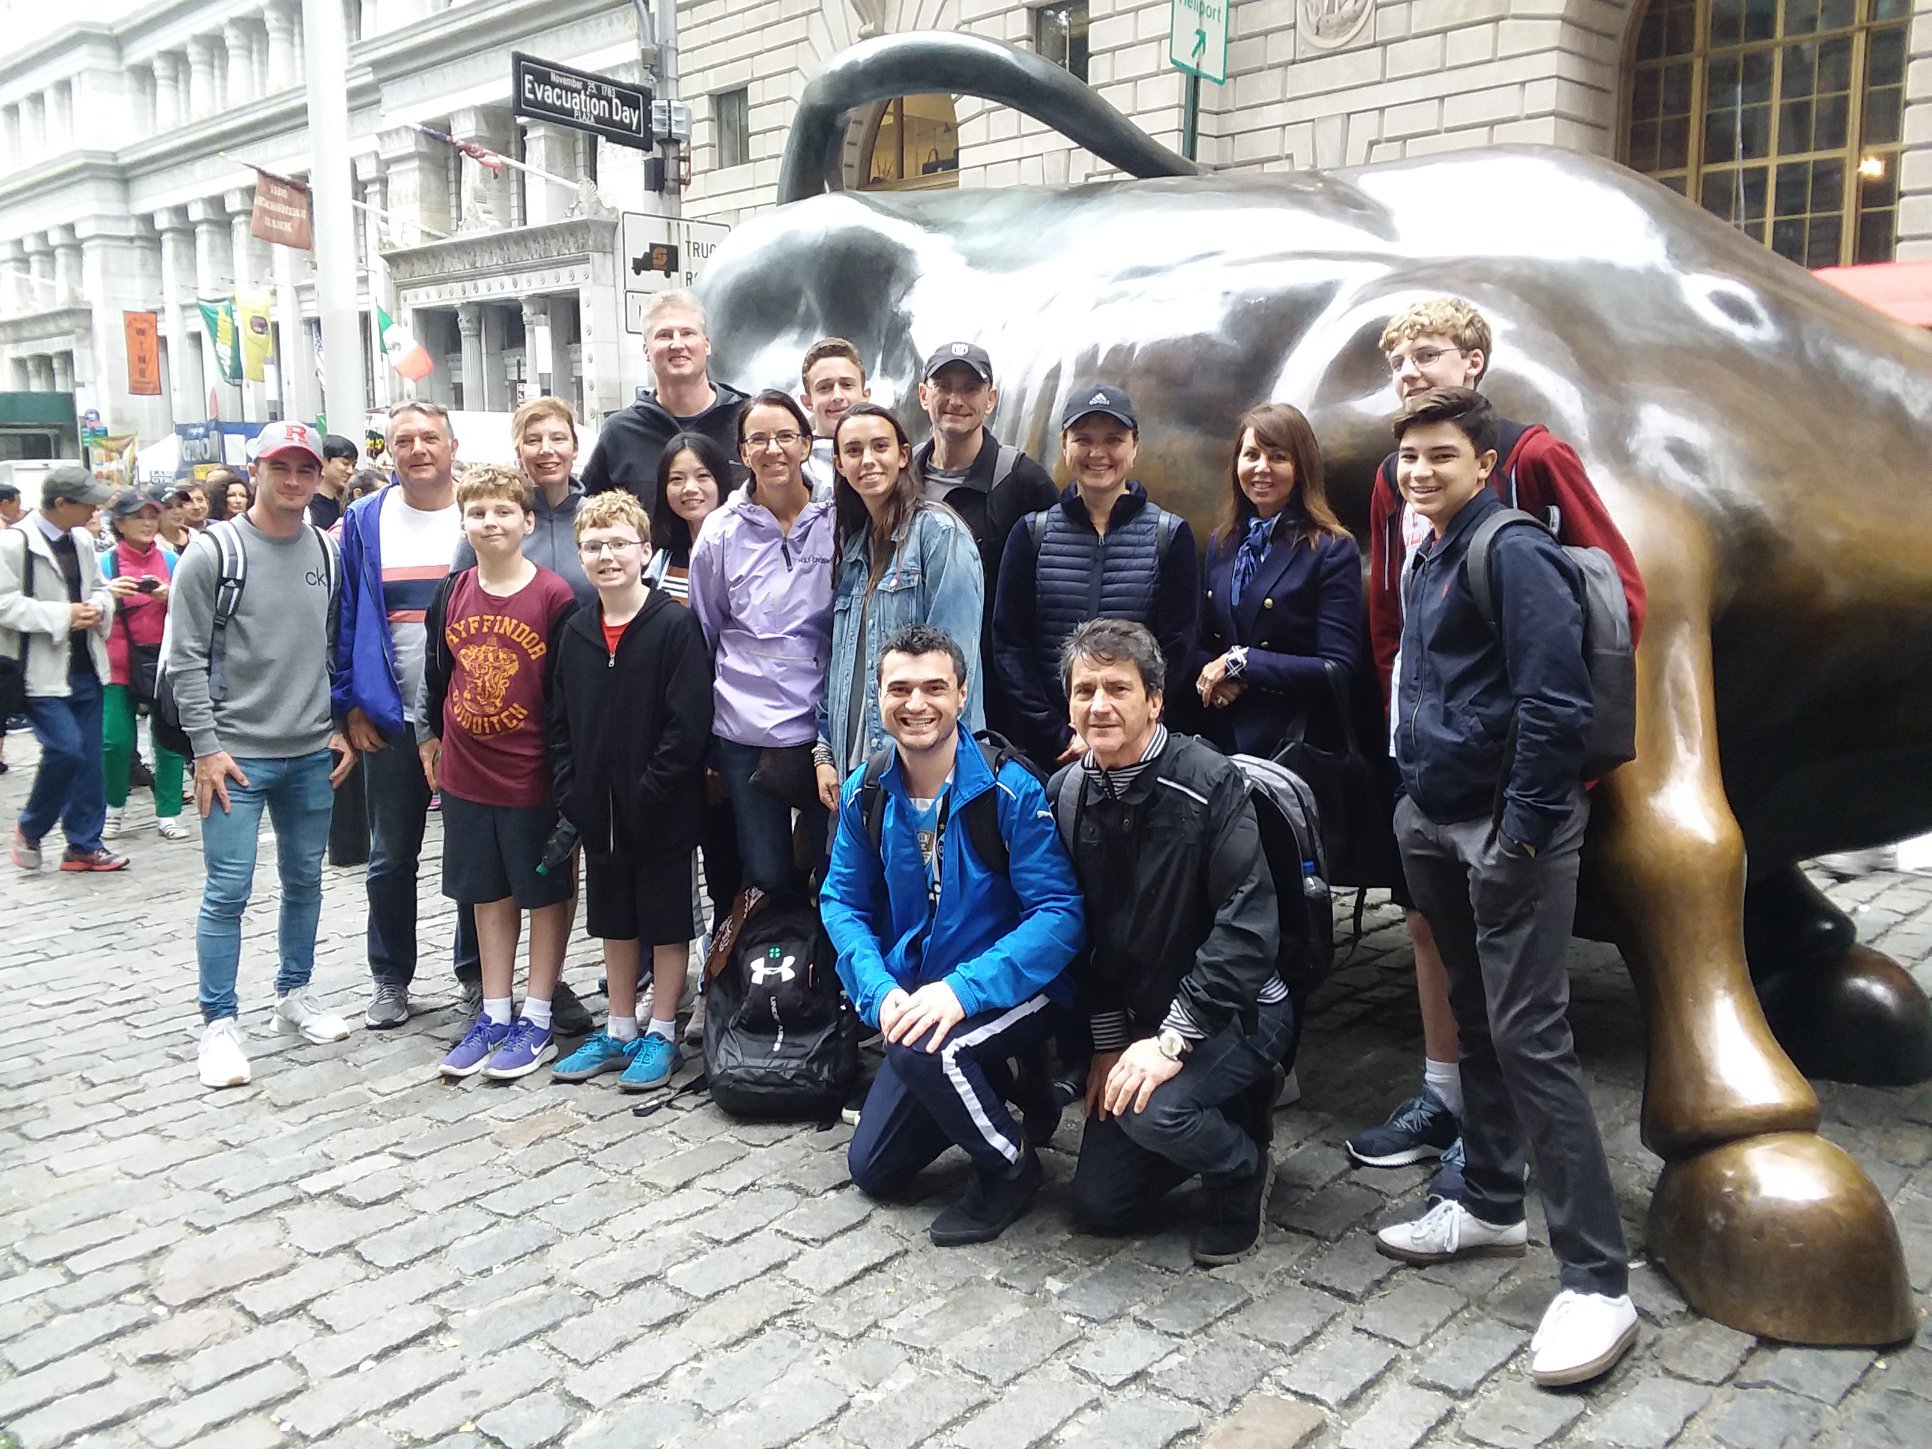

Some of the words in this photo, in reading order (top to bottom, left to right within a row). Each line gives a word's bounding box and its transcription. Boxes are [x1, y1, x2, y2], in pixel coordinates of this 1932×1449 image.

[1180, 0, 1221, 23] eliport
[550, 71, 583, 89] November
[601, 86, 616, 97] 1783
[524, 74, 609, 118] Evacuation
[612, 98, 639, 131] Day
[574, 109, 595, 124] PLAZA
[284, 424, 309, 444] R
[305, 566, 327, 587] ck
[446, 614, 547, 661] RYFFINDOR
